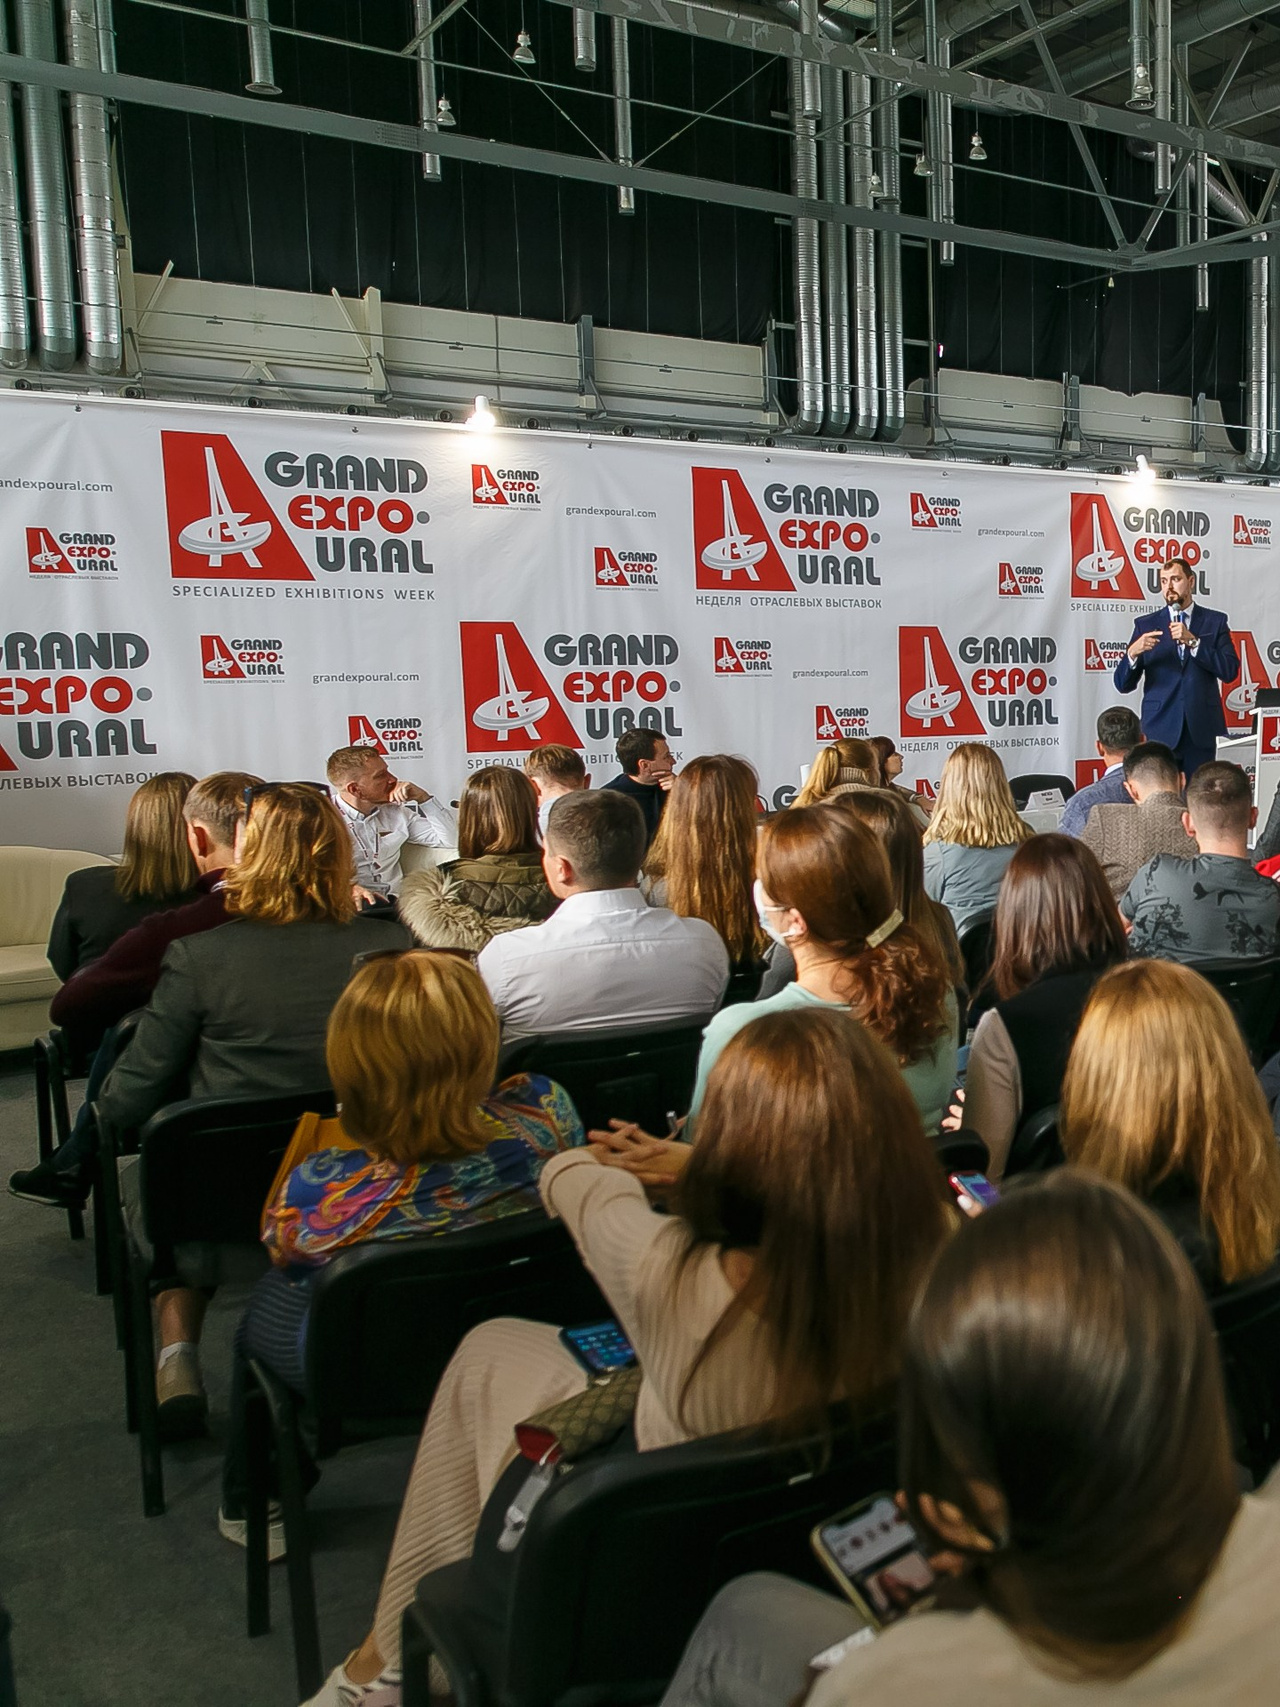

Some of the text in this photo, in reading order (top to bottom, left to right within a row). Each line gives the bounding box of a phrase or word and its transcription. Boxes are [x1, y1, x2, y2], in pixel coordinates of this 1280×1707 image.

[264, 451, 428, 493] GRAND
[497, 469, 539, 481] GRAND
[509, 493, 541, 504] URAL
[764, 483, 880, 518] GRAND
[929, 497, 960, 507] GRAND
[287, 495, 414, 533] EXPO
[566, 506, 657, 518] grandexpoural.com
[939, 517, 962, 527] URAL
[1123, 507, 1210, 537] GRAND
[1248, 519, 1271, 527] GRAND
[59, 533, 116, 545] GRAND
[779, 519, 869, 552] EXPO
[978, 528, 1045, 538] grandexpoural.com
[1253, 536, 1271, 544] URAL
[315, 536, 434, 573] URAL
[618, 552, 657, 562] GRAND
[76, 559, 118, 571] URAL
[798, 554, 881, 585] URAL
[1015, 566, 1043, 575] GRAND
[630, 574, 658, 584] URAL
[172, 585, 435, 600] SPECIALIZED EXHIBITIONS WEEK
[1022, 585, 1044, 593] URAL
[696, 596, 882, 608] НЕДЕЛЯ ОТРАСЛЕВЫХ ВЫСТАВОК
[1071, 603, 1126, 612] SPECIALIZED
[231, 639, 282, 650] GRAND
[544, 634, 679, 666] GRAND
[736, 641, 771, 650] GRAND
[959, 637, 1057, 664] GRAND
[0, 632, 150, 670] RAND
[247, 664, 285, 675] URAL
[746, 661, 772, 671] URAL
[313, 673, 420, 684] grandexpoural.com
[793, 668, 869, 678] grandexpoural.com
[563, 670, 667, 702] EXPO
[971, 668, 1047, 695] EXPO
[835, 708, 869, 717] GRAND
[988, 699, 1058, 727] URAL
[376, 718, 421, 729] GRAND
[585, 707, 683, 740] URAL
[845, 728, 869, 737] URAL
[17, 719, 157, 759] URAL
[900, 742, 939, 753] НЕДЕЛЯ
[1011, 737, 1060, 747] ВЫСТАВОК
[390, 741, 423, 752] URAL
